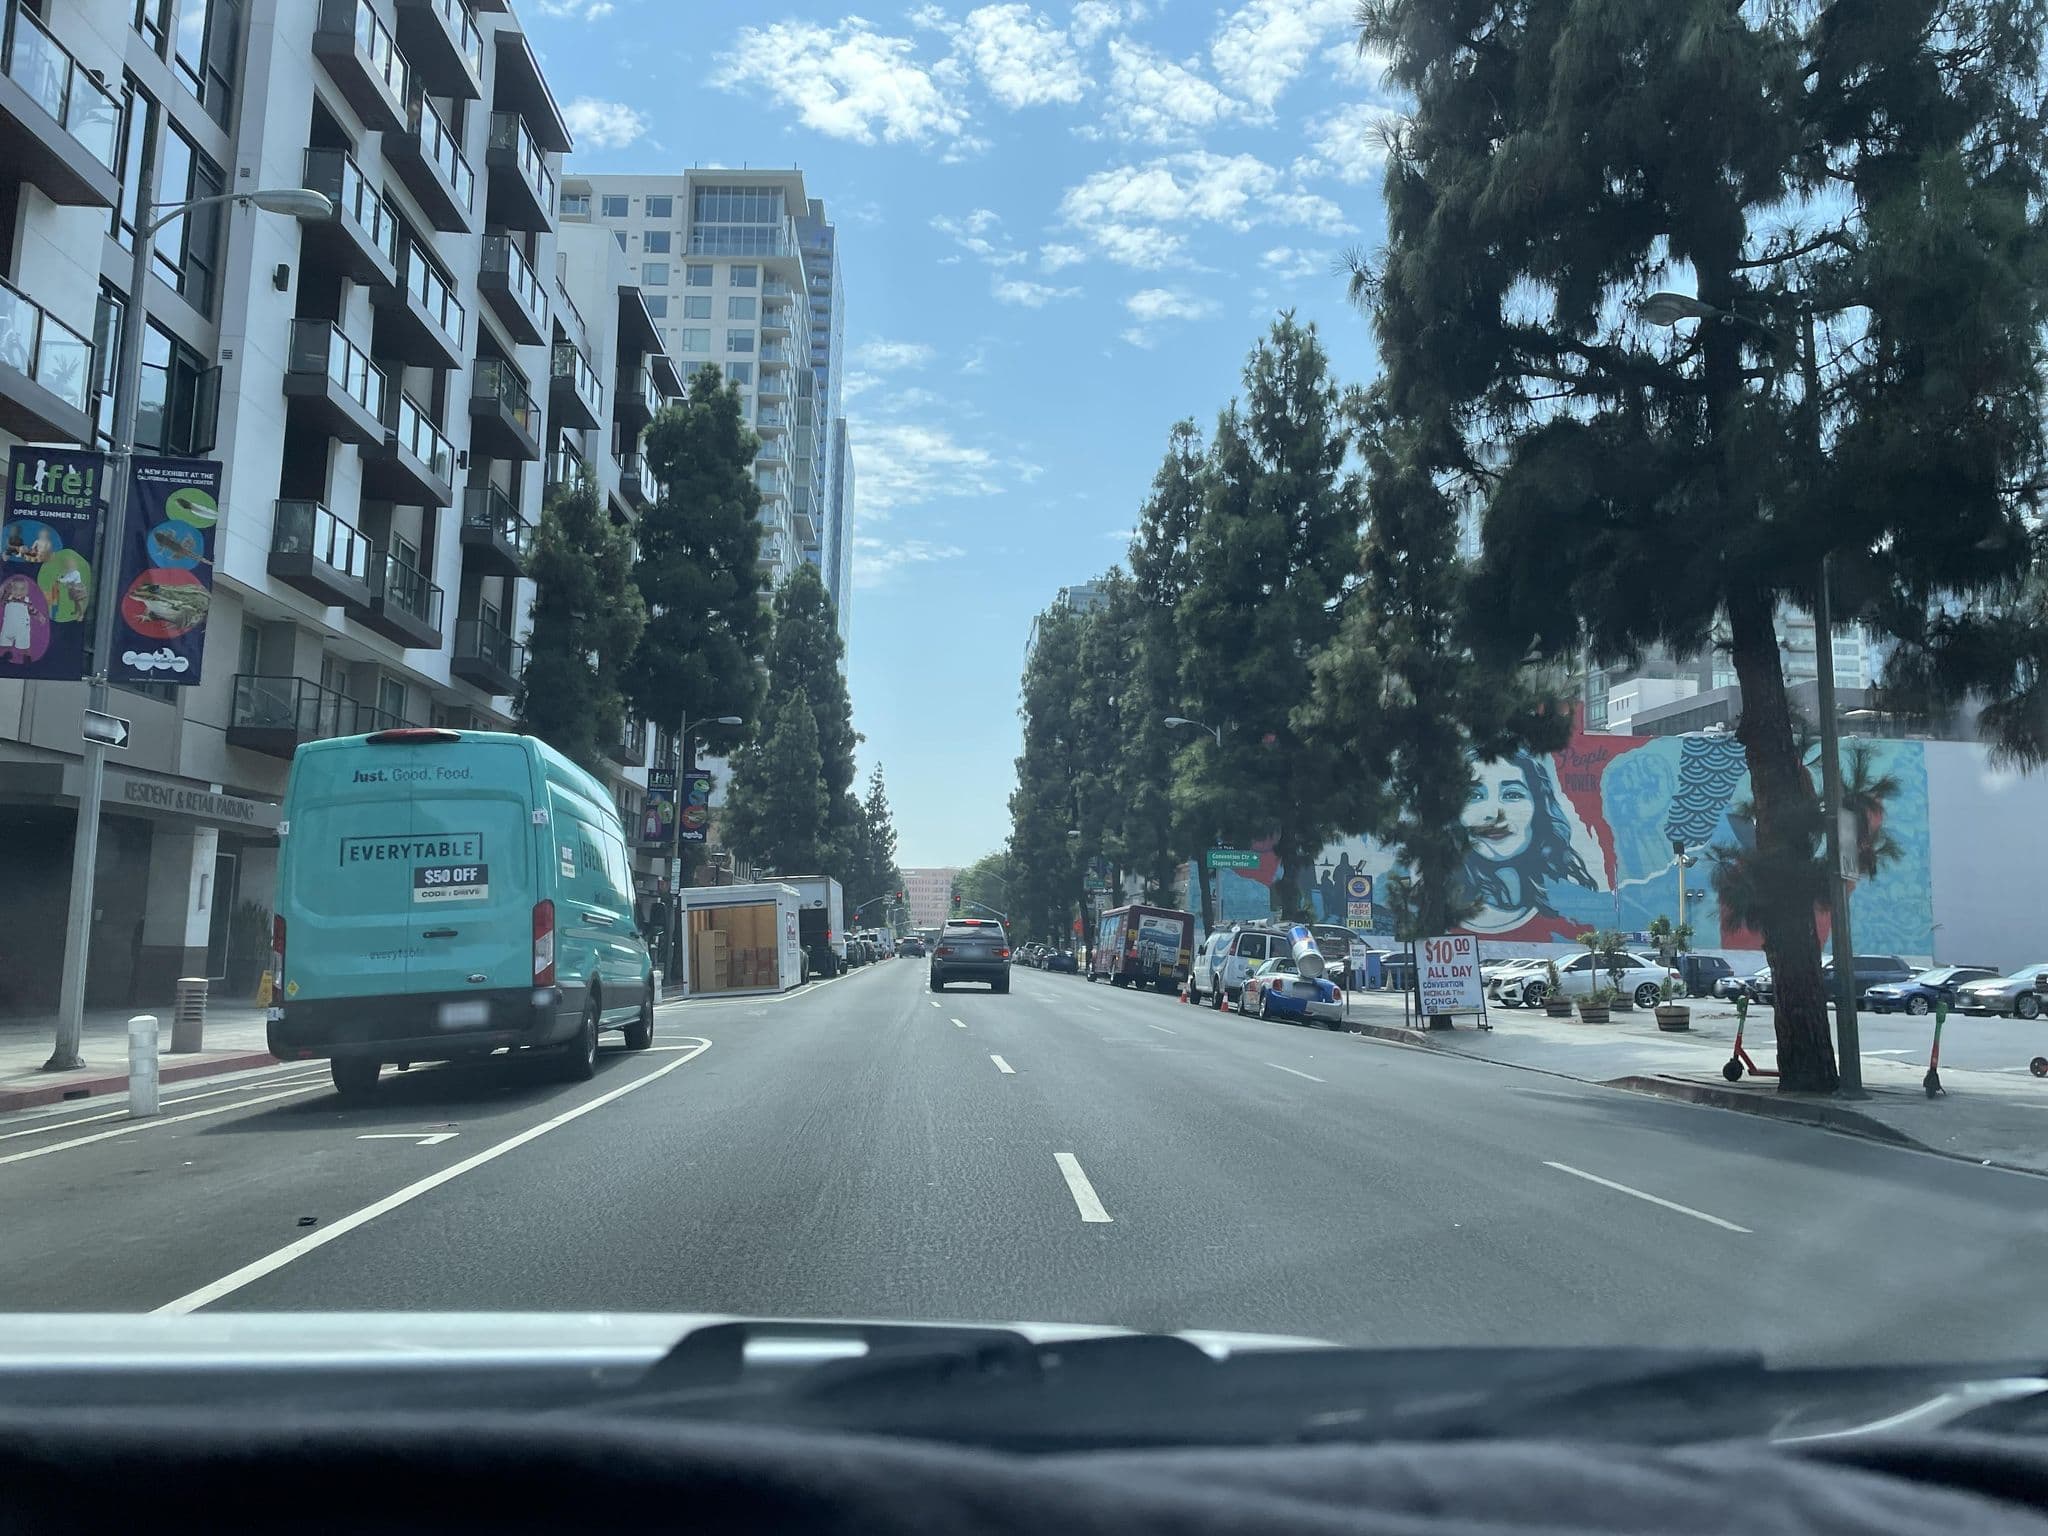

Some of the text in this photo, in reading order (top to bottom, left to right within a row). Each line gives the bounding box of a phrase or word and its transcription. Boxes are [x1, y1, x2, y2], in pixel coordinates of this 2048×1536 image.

[15, 460, 93, 496] Life!
[15, 491, 92, 508] Beginnings
[13, 508, 38, 516] OPENS
[39, 511, 72, 519] SUMMER
[352, 765, 473, 783] Just. Good. Food.
[124, 782, 254, 820] RESIDENT & RETAIL PARKING
[350, 841, 473, 861] EVERYTABLE
[424, 867, 478, 884] $50 OFF
[1348, 920, 1370, 928] FIDM
[1425, 939, 1453, 964] $10
[1427, 965, 1472, 978] ALL DAY
[1423, 980, 1464, 989] CONVENTION
[1424, 997, 1459, 1006] CONGA
